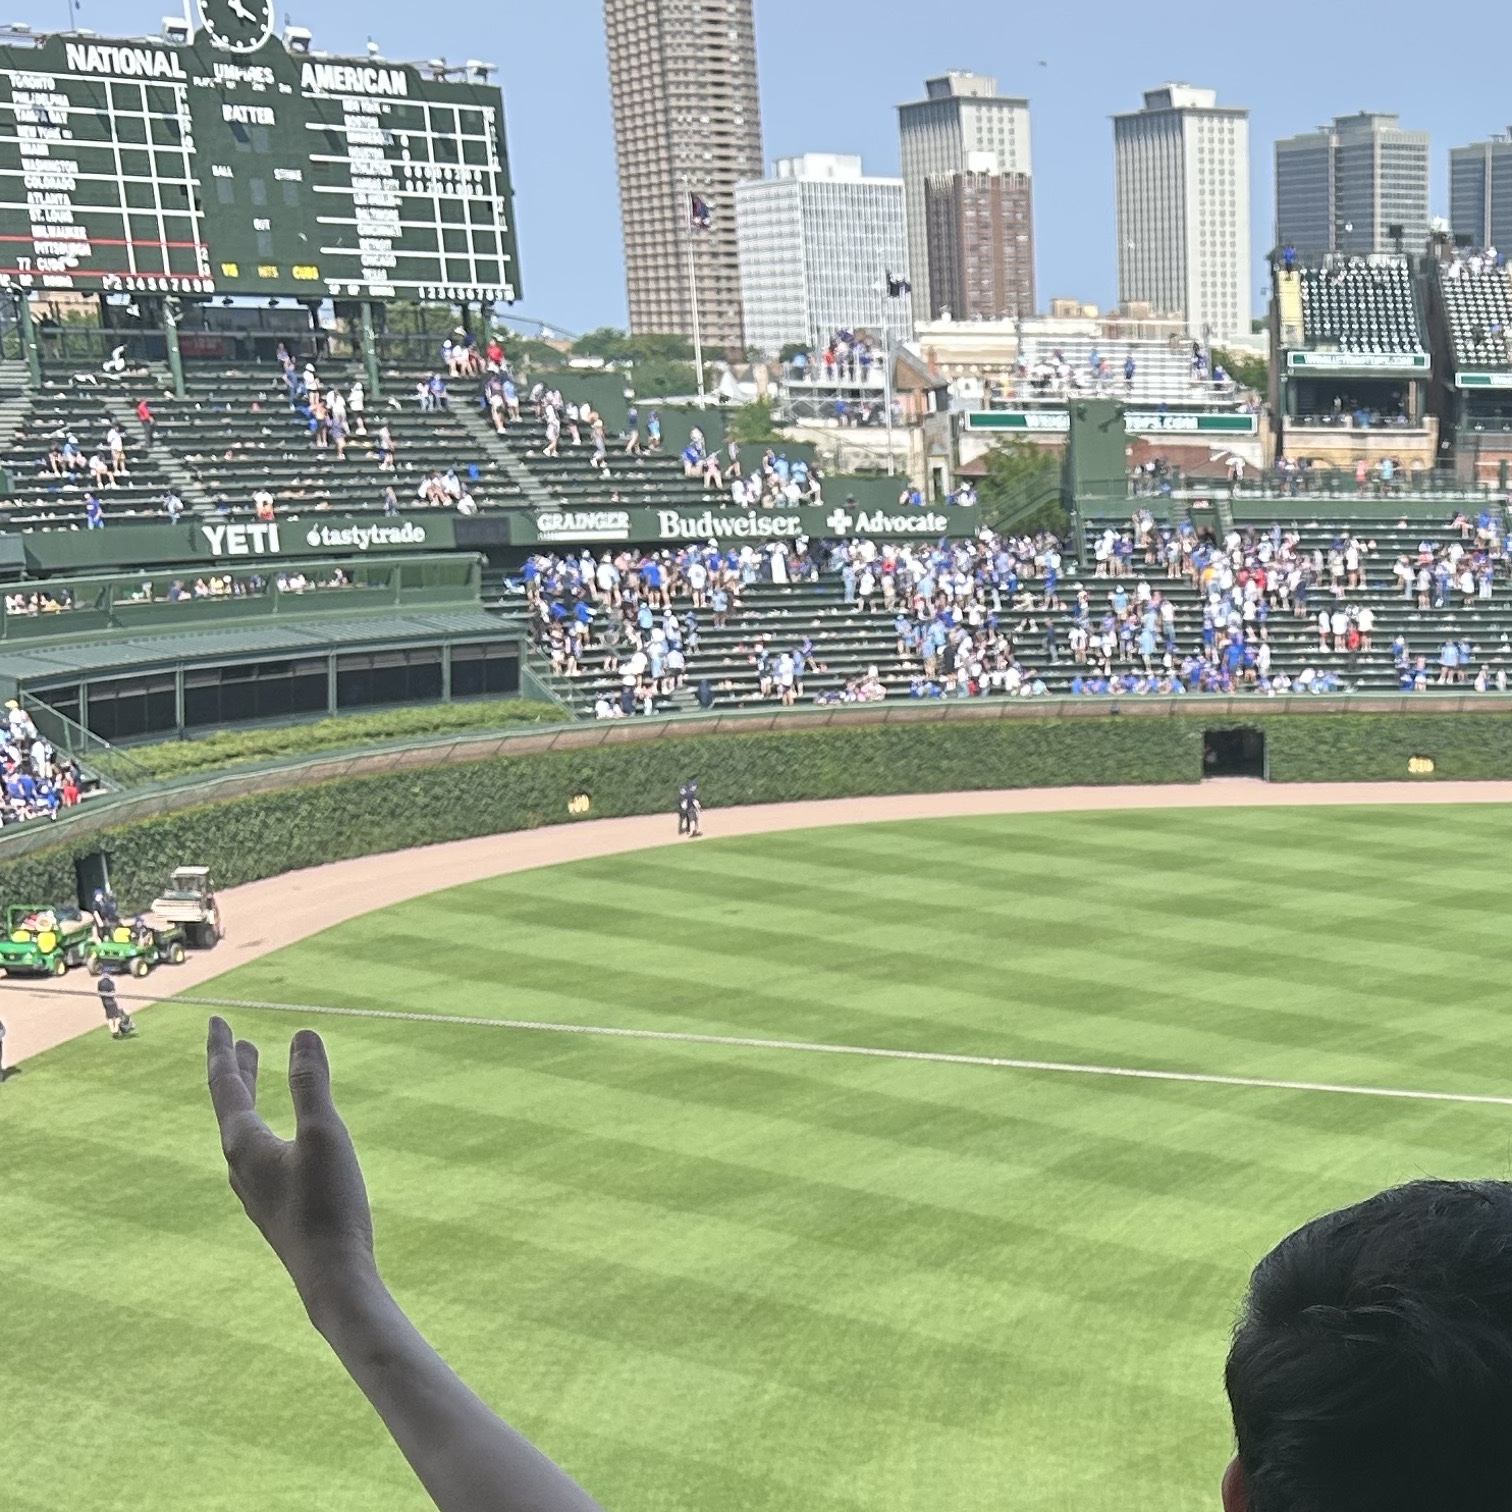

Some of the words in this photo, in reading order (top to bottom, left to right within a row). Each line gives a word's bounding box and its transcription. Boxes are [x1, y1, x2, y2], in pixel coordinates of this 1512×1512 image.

[65, 42, 187, 79] NATIONAL
[301, 62, 408, 96] AMERICAN
[222, 104, 276, 125] BATTER
[537, 511, 631, 531] GRAINGER
[658, 510, 800, 538] Budweiser
[855, 509, 948, 532] Advocate
[202, 522, 280, 556] YETI
[321, 521, 426, 550] tastytrade
